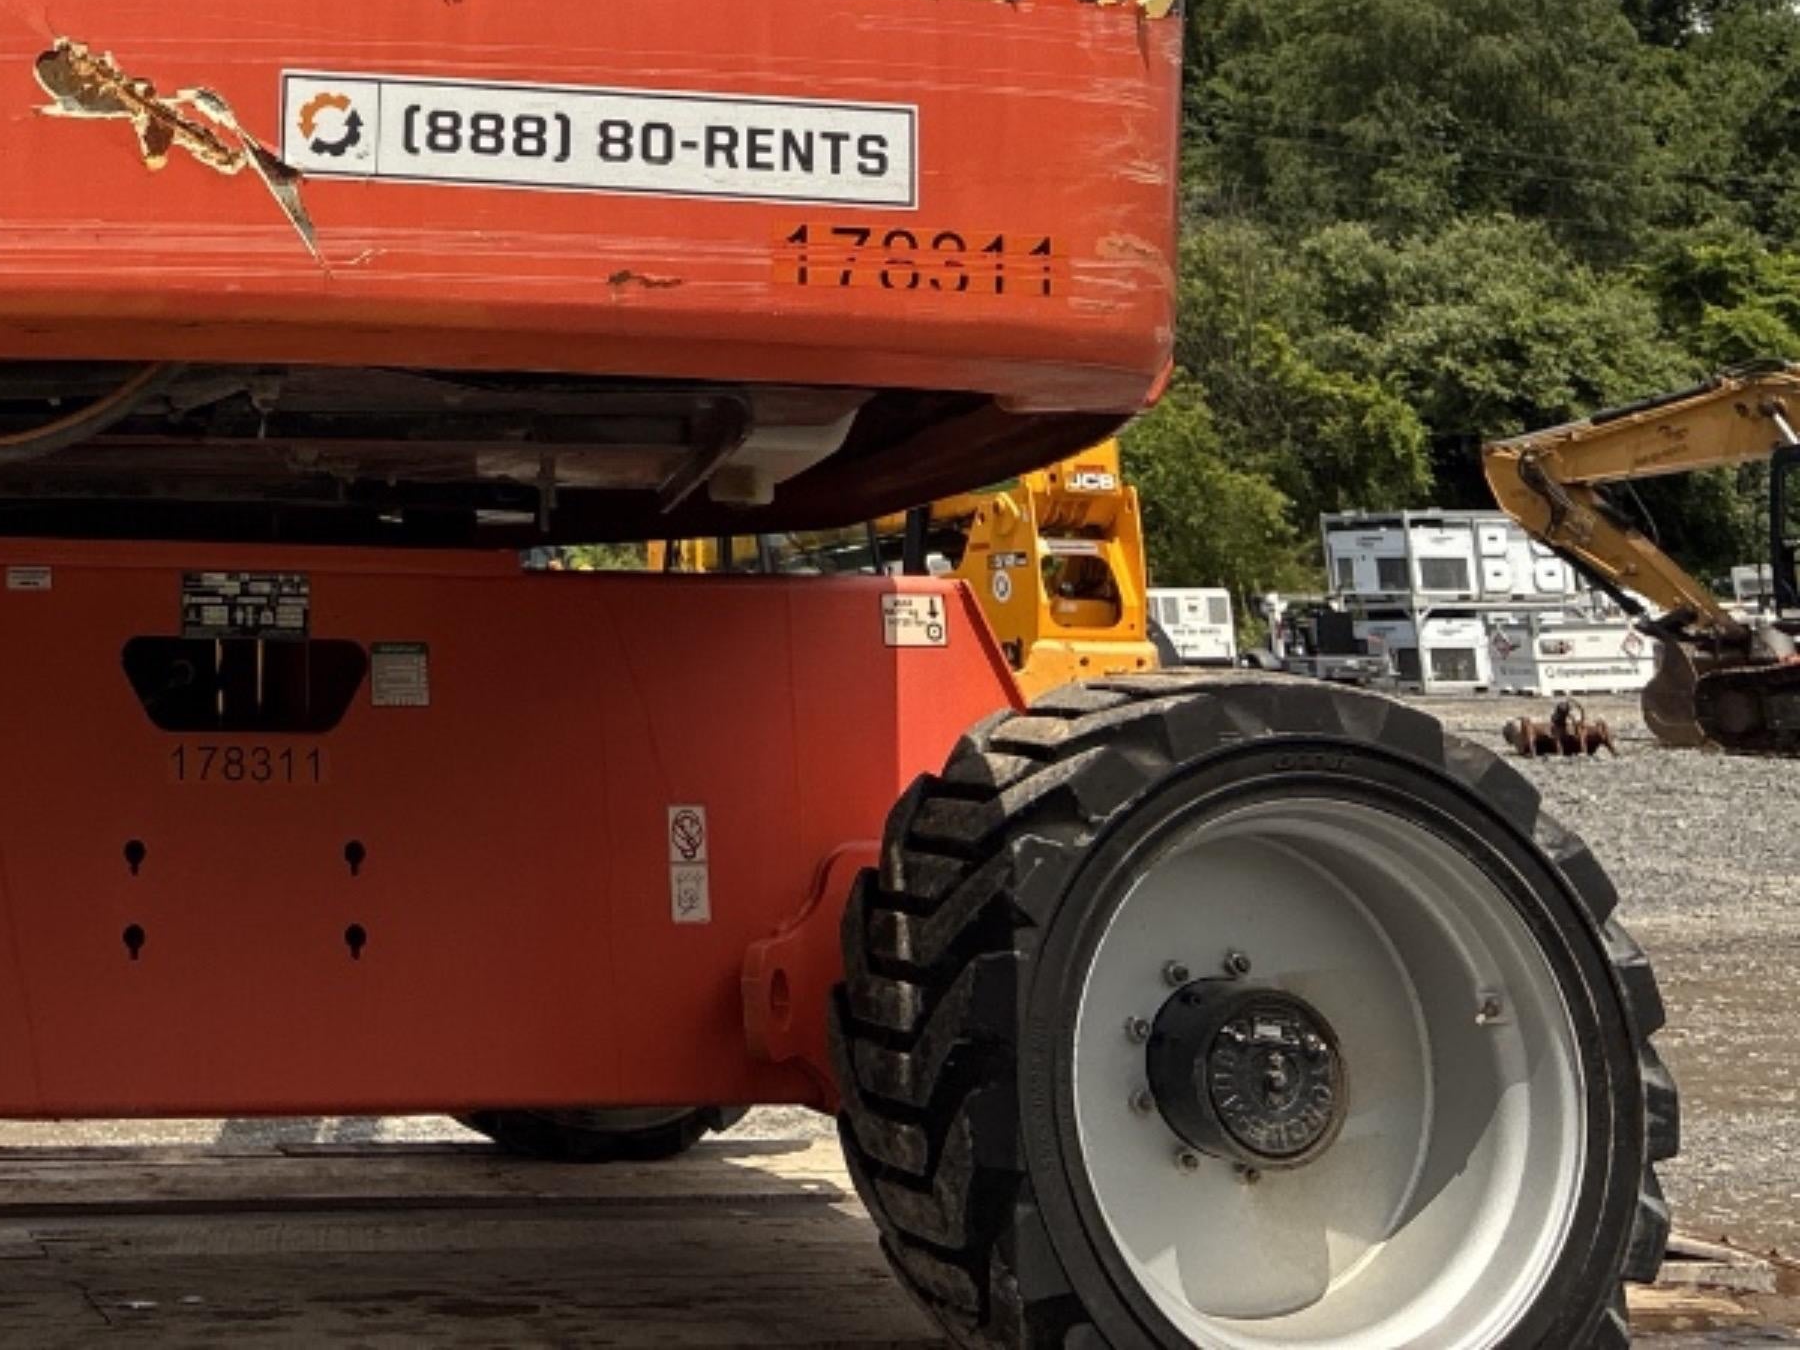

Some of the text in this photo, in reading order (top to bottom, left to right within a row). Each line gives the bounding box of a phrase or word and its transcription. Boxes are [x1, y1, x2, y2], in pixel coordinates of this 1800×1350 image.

[403, 103, 890, 177] (888) 80-RENTS
[786, 224, 1051, 295] 178311
[1065, 472, 1116, 491] JCB
[170, 743, 322, 783] 178311
